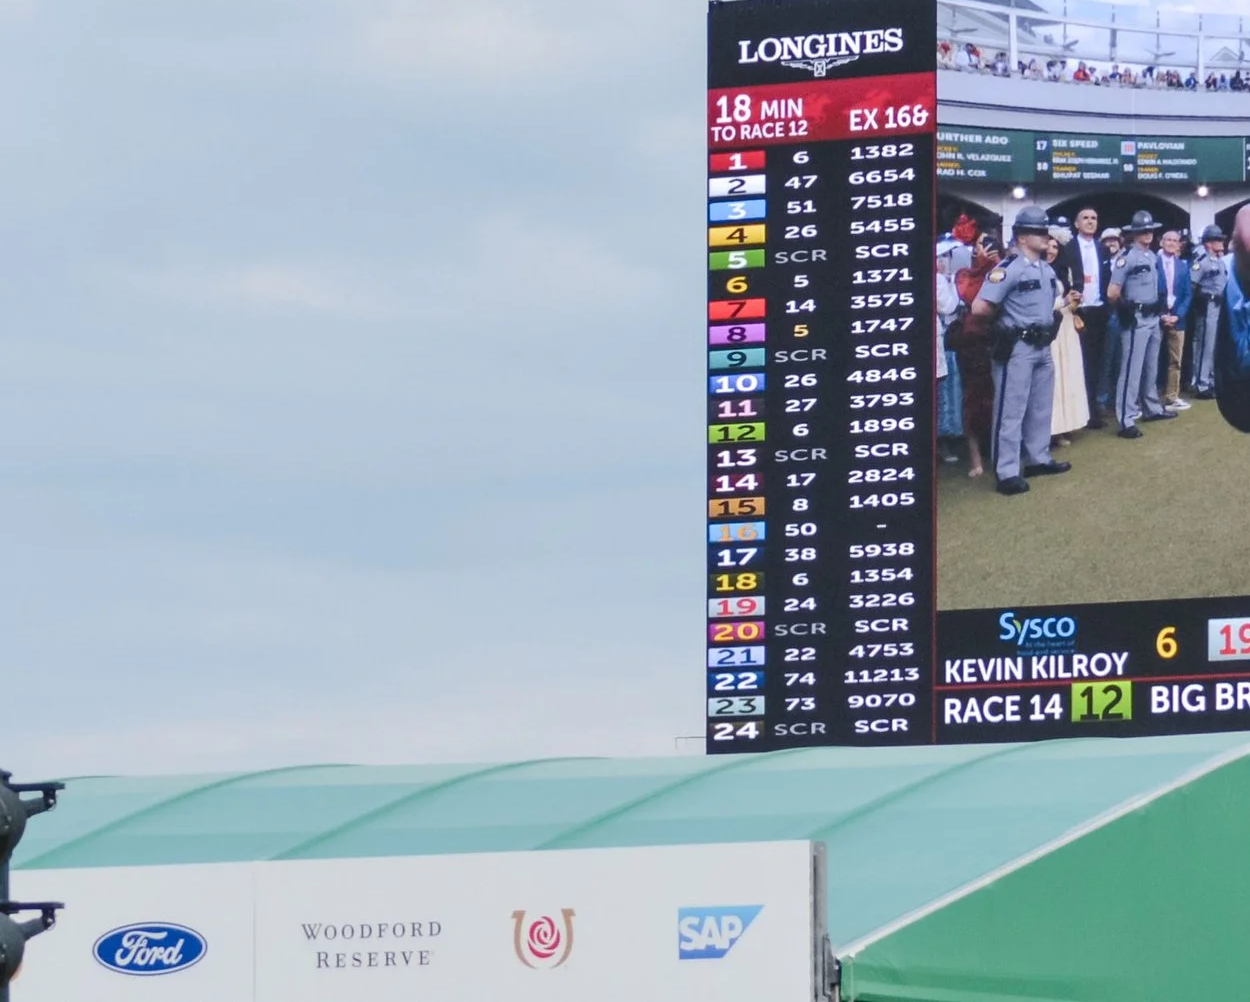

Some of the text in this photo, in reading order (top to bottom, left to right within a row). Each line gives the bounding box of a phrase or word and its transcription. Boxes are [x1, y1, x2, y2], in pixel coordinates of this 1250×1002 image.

[738, 28, 904, 64] LONGINES
[716, 94, 803, 124] 18 MIN
[850, 108, 878, 132] EX
[711, 120, 808, 141] TO RACE 12
[937, 132, 1008, 145] URTHER ADO
[1036, 140, 1047, 150] 17
[1069, 140, 1098, 148] SPEED
[1137, 142, 1185, 151] PAVLOVIAN
[728, 143, 914, 171] 1 6 1382
[727, 168, 915, 194] 2 47 6654
[728, 193, 913, 220] 3 51 7518
[726, 218, 915, 243] 4 26 5455
[727, 243, 909, 269] 5 SCR SCR
[726, 268, 913, 294] 6 5 1371
[728, 292, 914, 318] 7 14 3575
[726, 317, 914, 343] 8 5 1747
[727, 343, 909, 367] 9 SCR SCR
[715, 367, 917, 394] 10 26 4846
[718, 392, 914, 418] 11 27 3793
[717, 417, 915, 442] 12 6 1896
[716, 443, 909, 468] 13 SCR SCR
[716, 467, 915, 493] 14 17 2824
[717, 492, 915, 516] 15 8 1405
[719, 523, 757, 541] 16
[785, 523, 817, 537] 50
[717, 542, 915, 567] 17 38 5938
[716, 567, 913, 591] 18 6 1354
[717, 592, 915, 616] 19 24 3226
[714, 618, 909, 642] 20 SCR SCR
[1157, 627, 1177, 658] 6
[717, 643, 914, 665] 21 22 4753
[714, 667, 919, 691] 22 74 11213
[945, 650, 1129, 684] KEVIN KILROY
[716, 693, 916, 714] 23 73 9070
[944, 685, 1125, 724] RACE 14 12
[1150, 684, 1206, 713] BIG
[713, 718, 908, 741] 24 SCR SCR
[302, 921, 442, 941] WOODFORD
[680, 915, 743, 950] SAP
[115, 930, 184, 966] Ford
[316, 950, 431, 969] RESERVE
